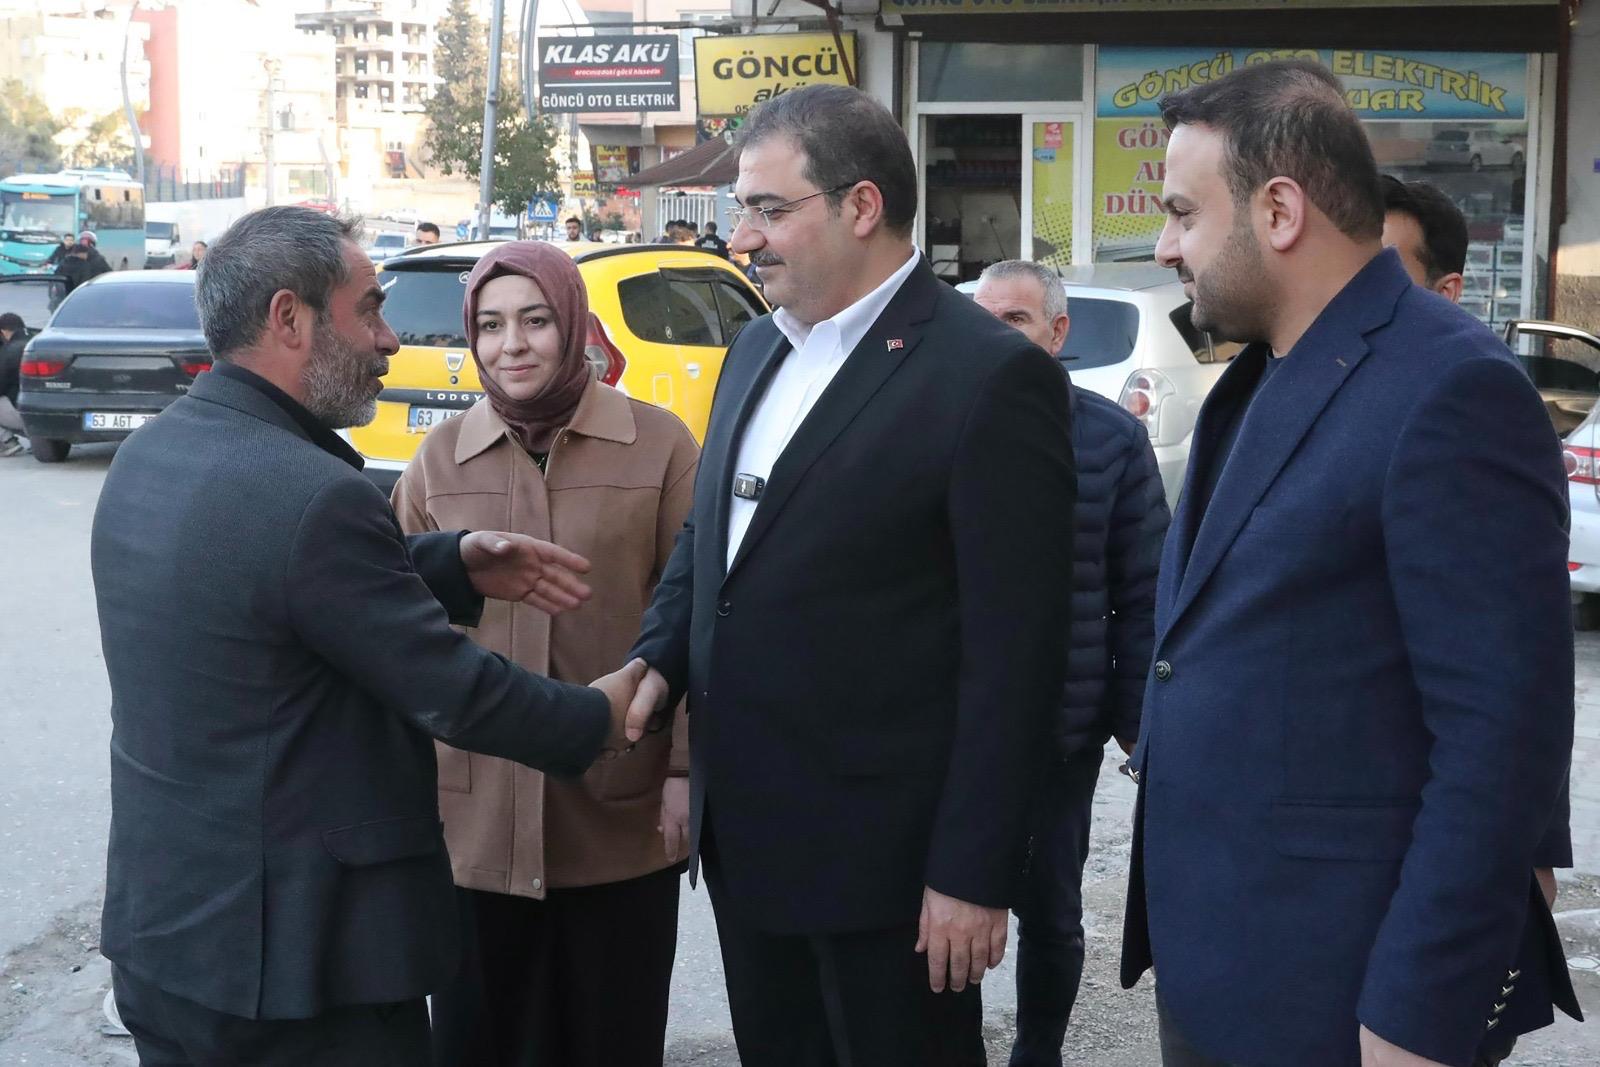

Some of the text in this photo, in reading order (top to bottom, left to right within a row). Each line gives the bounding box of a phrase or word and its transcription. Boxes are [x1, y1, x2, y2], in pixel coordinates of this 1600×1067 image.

[544, 43, 671, 63] KLAS AKÜ
[713, 47, 839, 80] GÖNCÜ
[1113, 50, 1233, 109] GÖNCÜ
[1332, 49, 1507, 113] ELEKTRİK
[542, 93, 675, 107] GÖNCÜ OTO ELEKTRİK
[1344, 88, 1425, 112] UAR
[1105, 188, 1167, 215] DÜN
[92, 414, 106, 428] 63
[112, 415, 133, 428] AGT
[417, 409, 433, 426] 63
